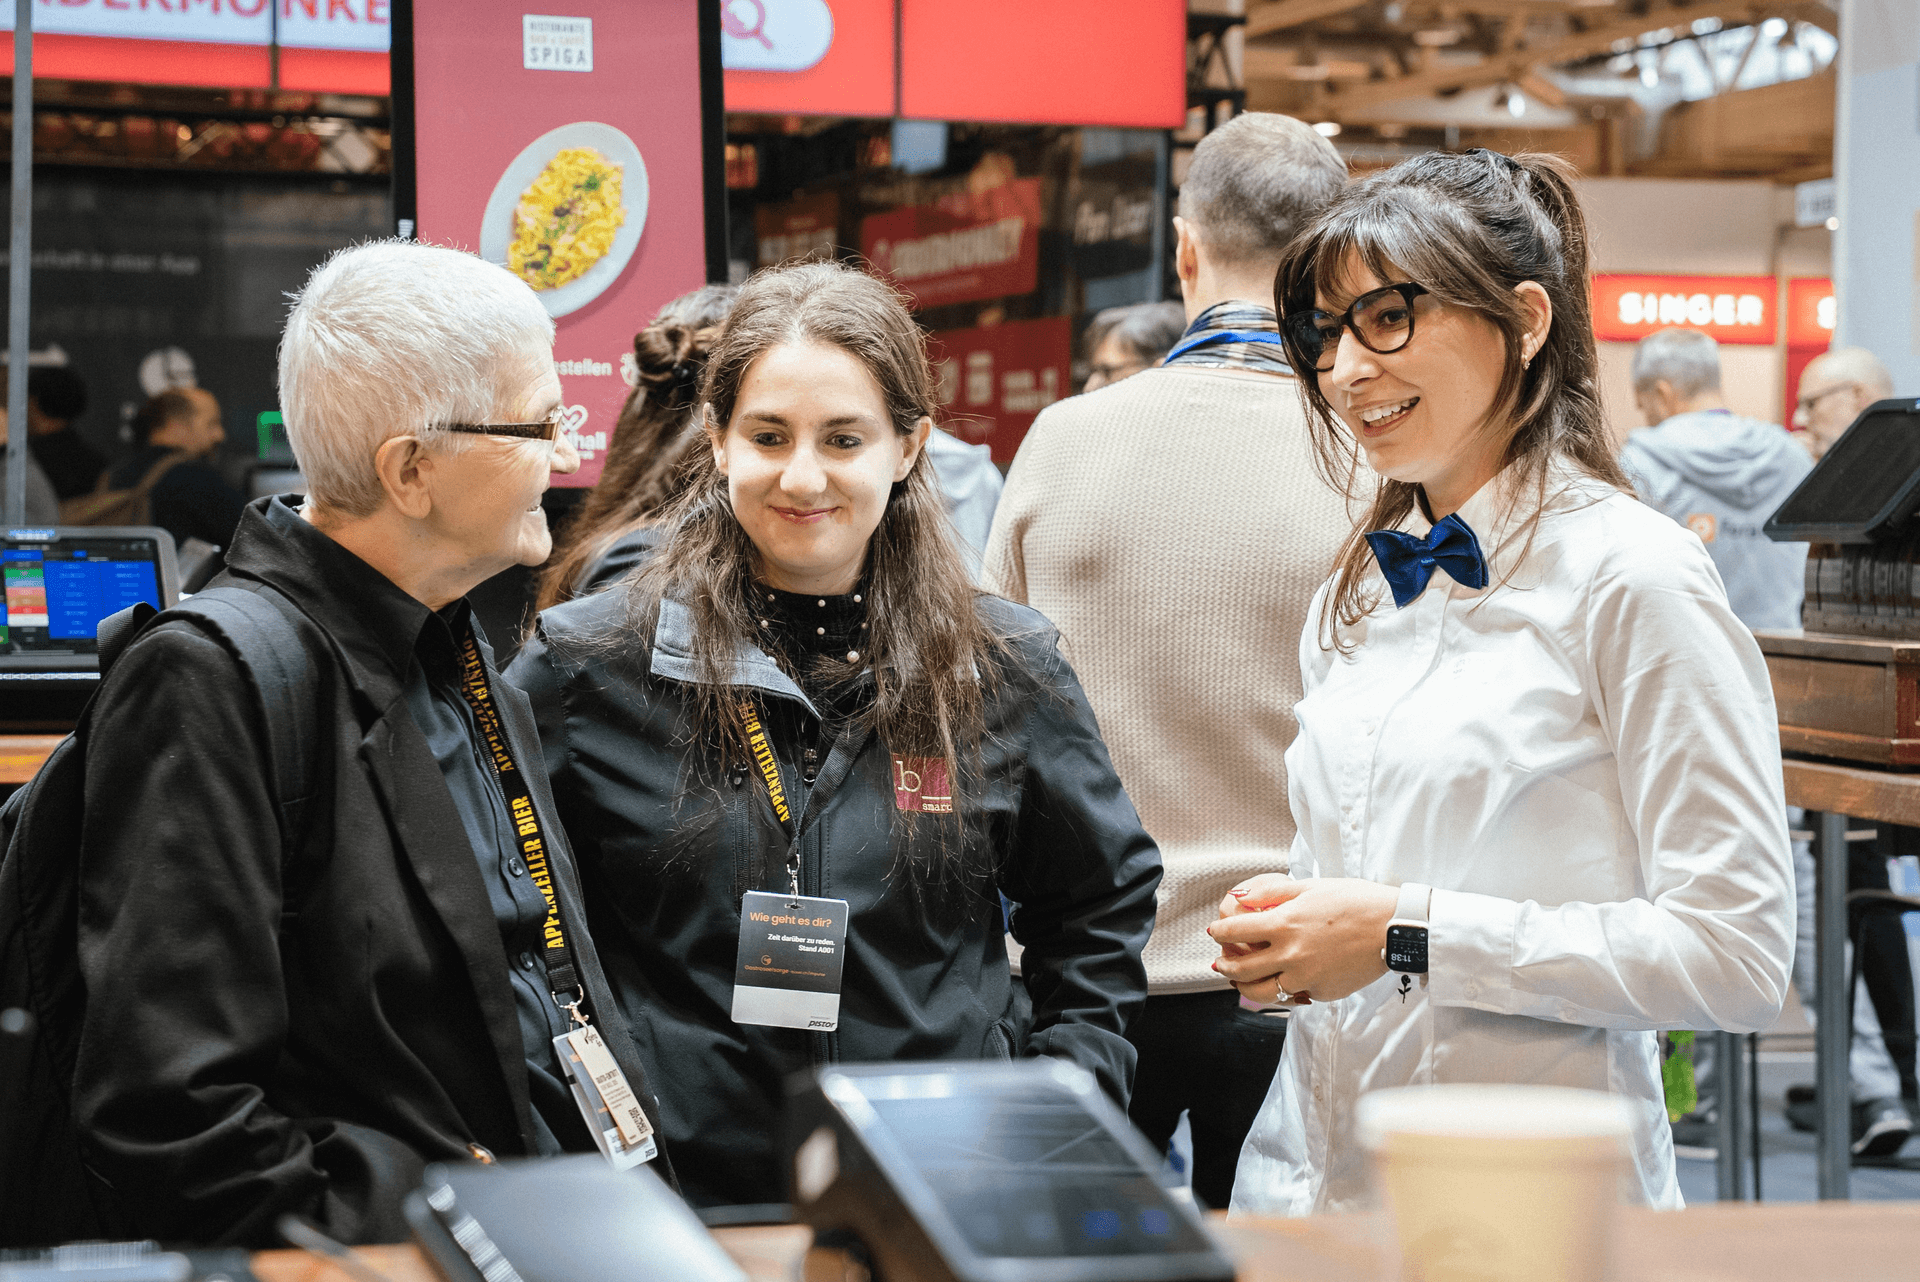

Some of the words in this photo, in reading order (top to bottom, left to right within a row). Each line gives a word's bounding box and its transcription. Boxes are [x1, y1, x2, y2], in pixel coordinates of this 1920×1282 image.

[530, 46, 586, 65] SPIGA
[1618, 291, 1763, 326] SINGER
[750, 732, 790, 823] APPENZELLER
[896, 760, 922, 793] b
[511, 795, 538, 837] BIER
[749, 911, 770, 922] Wie
[771, 914, 796, 926] geht
[797, 917, 810, 926] es
[811, 917, 832, 928] dir?
[767, 933, 781, 941] Zeit
[781, 935, 806, 944] darüber
[815, 938, 836, 946] reden.
[798, 944, 817, 953] Stand
[817, 946, 835, 954] A001
[1391, 953, 1411, 962] 11:38
[808, 1020, 836, 1028] pistor
